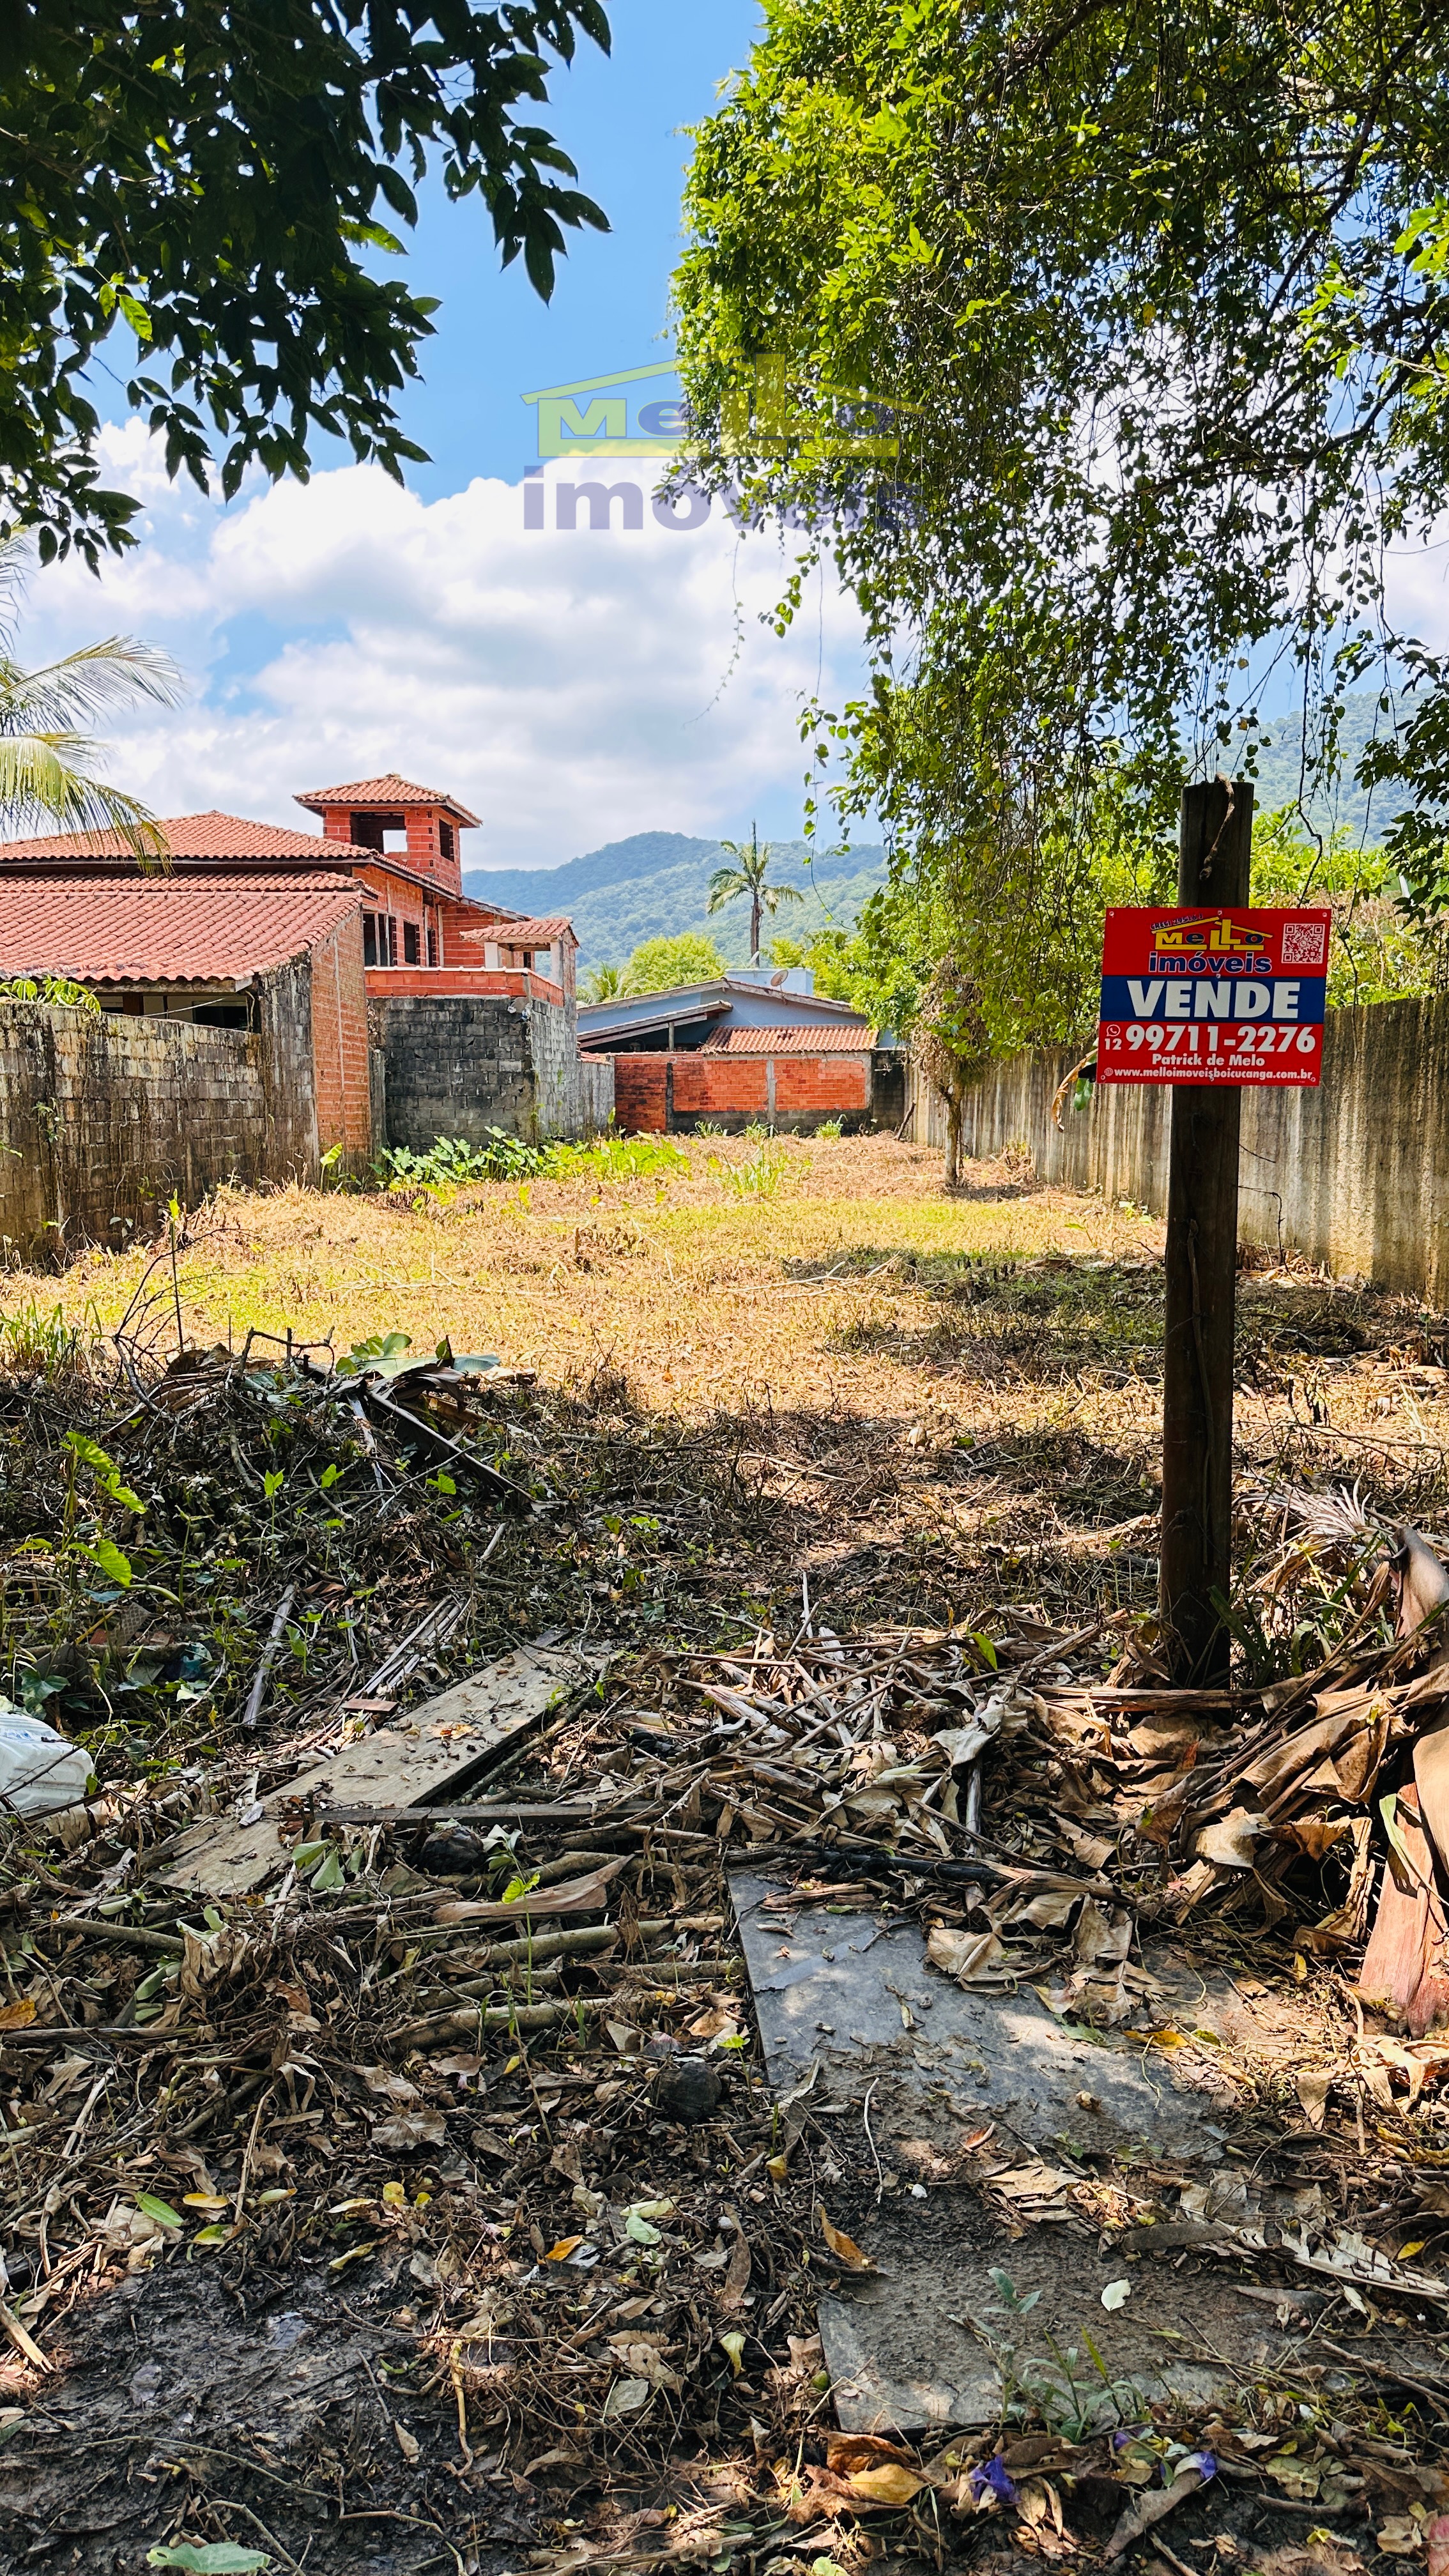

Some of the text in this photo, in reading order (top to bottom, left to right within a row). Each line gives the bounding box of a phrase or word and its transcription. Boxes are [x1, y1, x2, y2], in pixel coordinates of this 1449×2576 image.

[1148, 951, 1272, 974] imóveis
[1126, 981, 1300, 1018] VENDE
[1105, 1024, 1315, 1053] 12 99711-2276
[1152, 1053, 1265, 1066] Patrick de Melo
[1114, 1067, 1313, 1080] www.melloimoveisboicucanga.com.br
